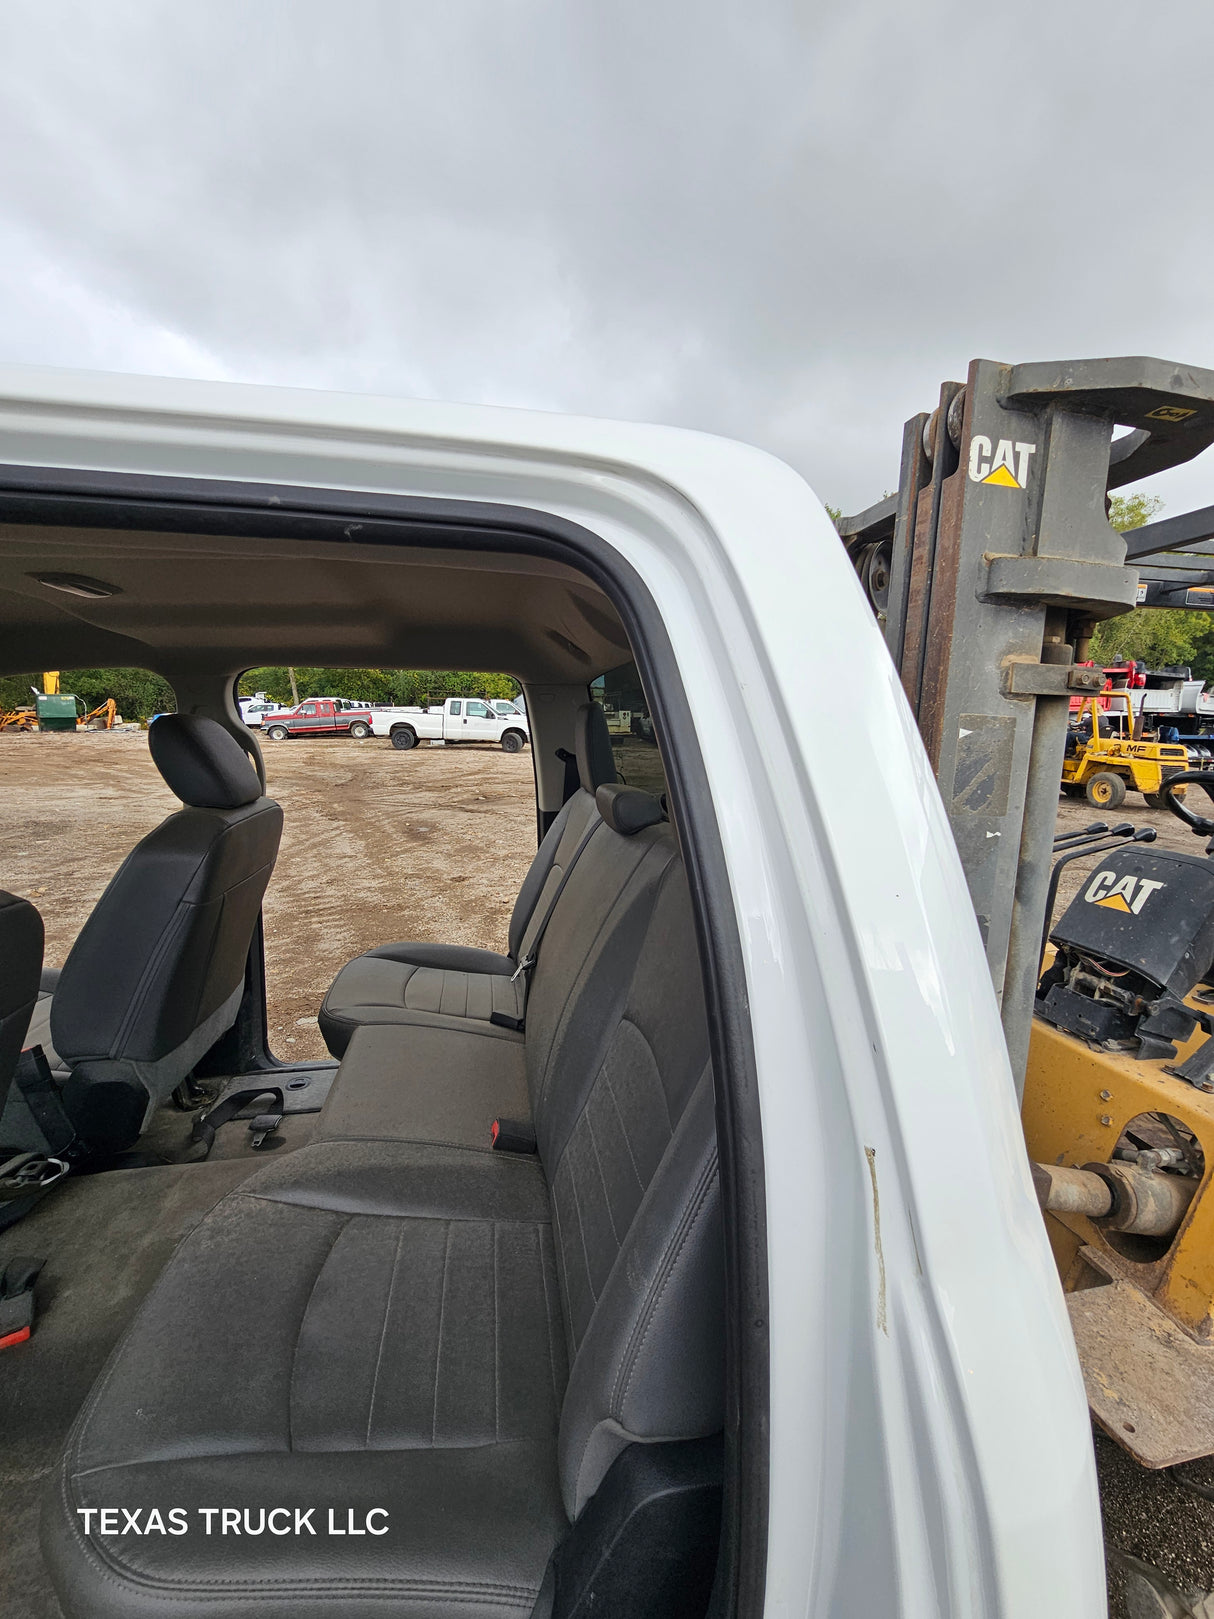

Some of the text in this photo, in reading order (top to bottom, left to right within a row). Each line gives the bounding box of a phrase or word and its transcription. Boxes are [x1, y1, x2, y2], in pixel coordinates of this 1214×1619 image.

[968, 435, 1036, 489] CAT
[1126, 744, 1147, 753] MF
[1084, 870, 1164, 915] CAT
